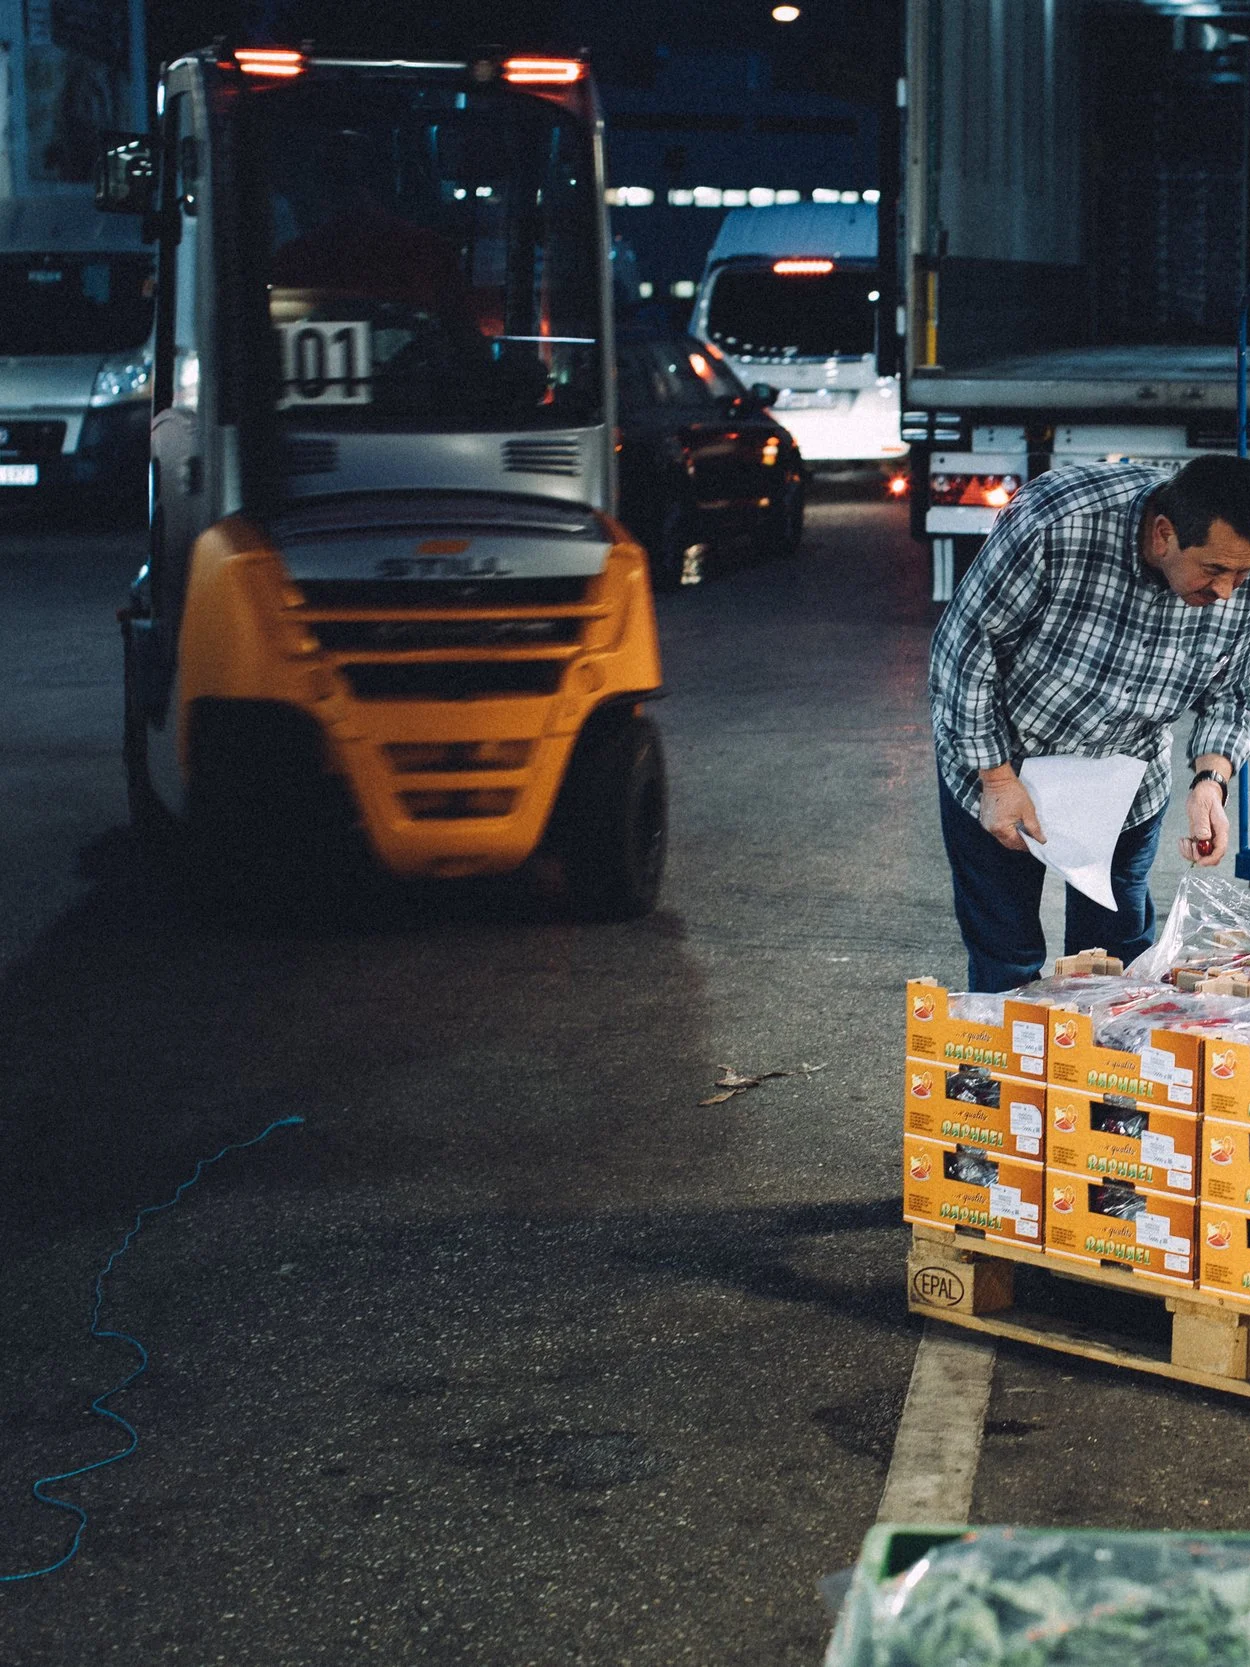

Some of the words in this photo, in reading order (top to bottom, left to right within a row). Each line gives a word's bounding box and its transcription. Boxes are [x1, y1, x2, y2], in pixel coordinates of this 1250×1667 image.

[944, 1041, 1008, 1069] RAPHAEL
[1087, 1069, 1154, 1098] RAPHAEL
[941, 1119, 1004, 1148] RAPHAEL
[1087, 1154, 1154, 1183] RAPHAEL
[940, 1202, 1003, 1231] RAPHAEL
[1085, 1235, 1151, 1265] RAPHAEL
[921, 1273, 957, 1300] EPAL
